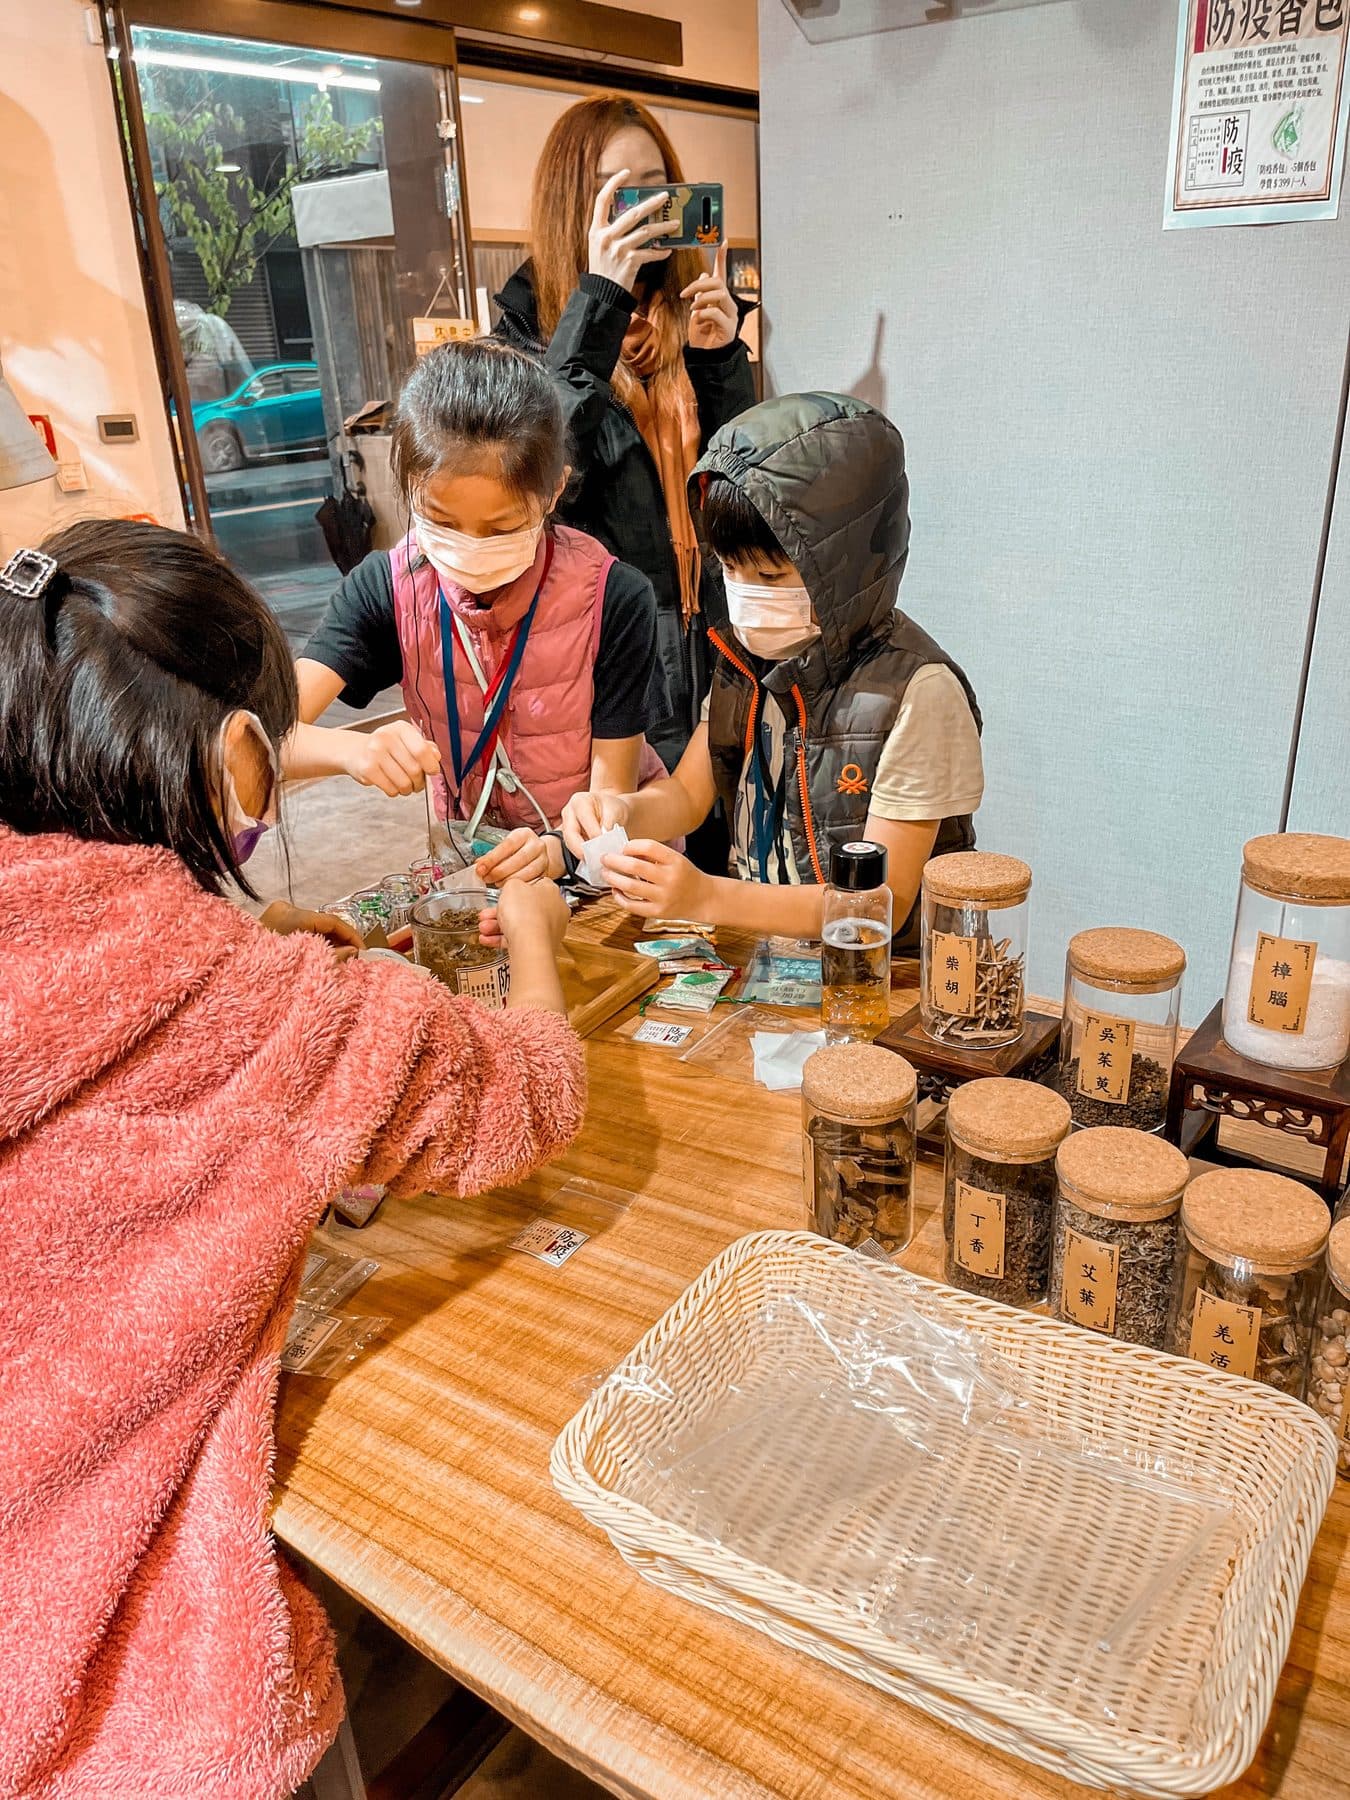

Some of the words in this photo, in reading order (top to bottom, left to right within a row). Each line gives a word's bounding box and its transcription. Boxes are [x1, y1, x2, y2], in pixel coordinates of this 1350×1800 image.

[1223, 116, 1243, 175] 防疫
[946, 956, 959, 995] 柴胡
[1267, 961, 1292, 1008] 樟腦
[1094, 1027, 1117, 1093] 吳茱萸
[969, 1213, 986, 1254] 丁香
[1079, 1263, 1098, 1307] 艾葉
[1210, 1323, 1235, 1369] 羌活
